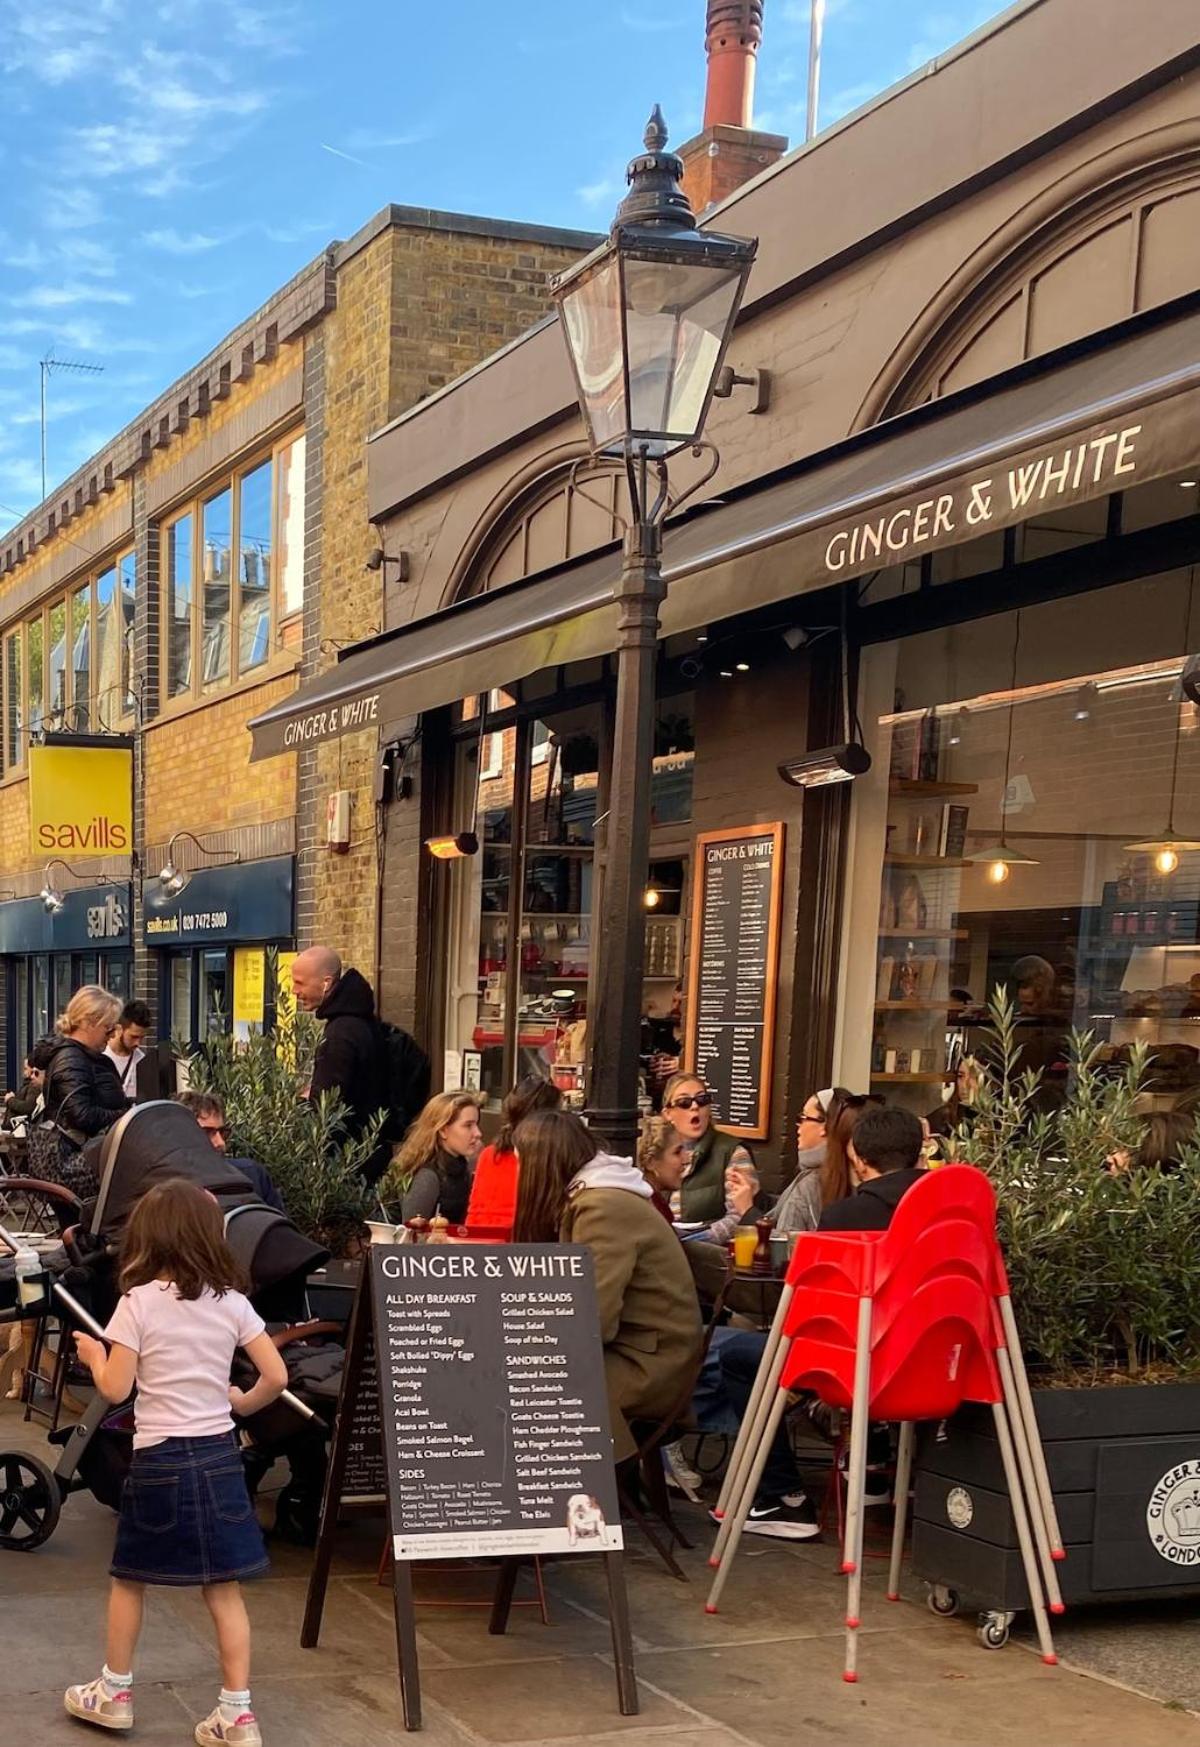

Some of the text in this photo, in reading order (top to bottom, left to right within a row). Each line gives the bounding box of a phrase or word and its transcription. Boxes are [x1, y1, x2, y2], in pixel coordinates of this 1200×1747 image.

[824, 425, 1142, 571] GINGER & WHITE
[284, 695, 380, 746] GINGER & WHITE
[38, 816, 126, 849] savills
[708, 841, 774, 862] GINGER & WHITE
[183, 914, 194, 930] 020
[195, 912, 210, 929] 7472
[211, 911, 227, 928] 5000
[382, 1256, 584, 1278] GINGER & WHITE
[386, 1294, 477, 1304] ALL DAY BREAKFAST
[501, 1293, 573, 1302] SOUP & SALADS
[387, 1310, 406, 1318] Toast
[423, 1309, 451, 1319] Spreads
[502, 1307, 574, 1316] Grilled Chicken Salad
[388, 1323, 443, 1334] Scrambled Eggs
[526, 1321, 545, 1329] Salad
[389, 1337, 418, 1345] Poached
[429, 1337, 446, 1345] Fried
[448, 1337, 464, 1347] Eggs
[504, 1336, 522, 1345] Soup
[523, 1335, 531, 1343] of
[544, 1335, 558, 1345] Day
[390, 1351, 406, 1360] Soft
[406, 1351, 429, 1359] Boiled
[458, 1350, 474, 1361] Eggs
[506, 1355, 567, 1365] SANDWICHES
[391, 1366, 427, 1374] Shakshuka
[507, 1371, 537, 1379] Smashed
[392, 1380, 422, 1390] Porridge
[509, 1384, 563, 1393] Bacon Sandwich
[394, 1394, 422, 1402] Granola
[395, 1408, 430, 1416] Acai Bowl
[511, 1411, 584, 1421] Goats Cheese Toastie
[428, 1421, 448, 1429] Toast
[530, 1426, 559, 1434] Cheddar
[397, 1435, 474, 1445] Smoked Salmon Bagel
[348, 1443, 364, 1451] DES
[529, 1440, 550, 1450] Finger
[416, 1450, 423, 1458] &
[452, 1449, 485, 1457] Croissant
[541, 1454, 569, 1462] Chicken
[569, 1453, 602, 1461] Sandwich
[399, 1470, 425, 1478] SIDES
[516, 1467, 581, 1476] Salt Beef Sandwich
[518, 1481, 583, 1490] Breakfast Sandwich
[1149, 1464, 1192, 1519] GINGER
[518, 1496, 554, 1505] Tuna Melt
[521, 1510, 551, 1519] The Elvis
